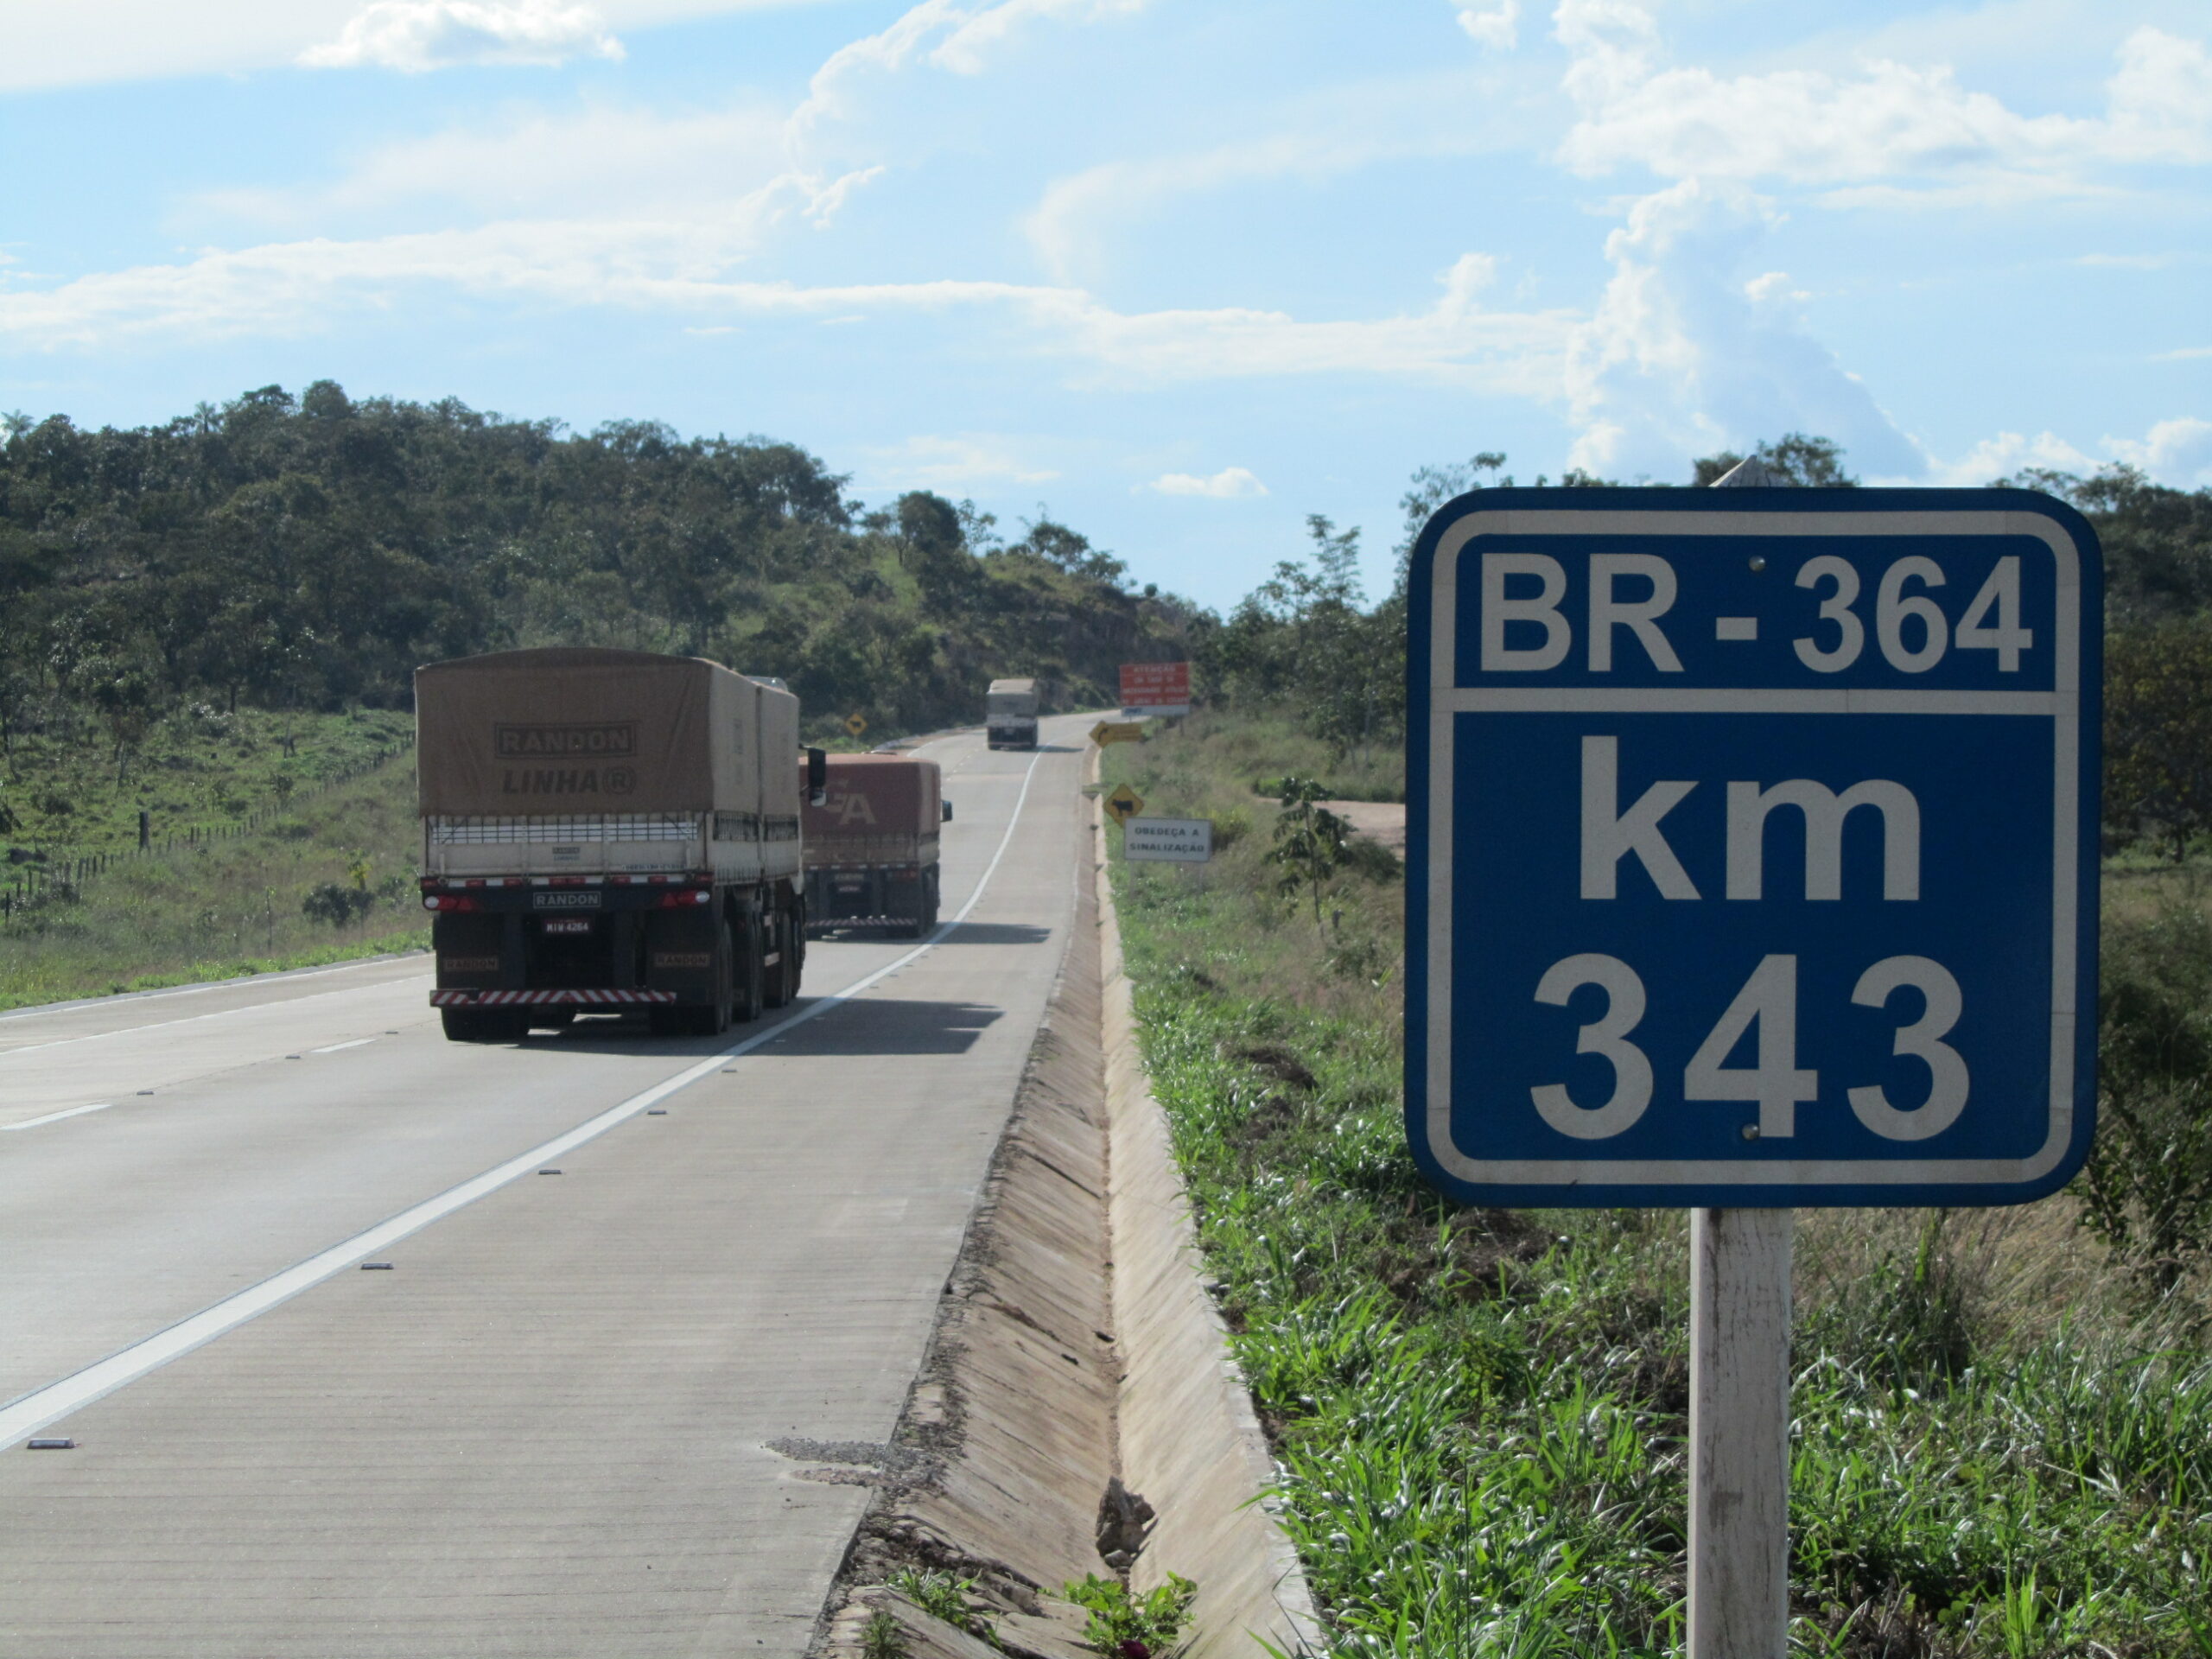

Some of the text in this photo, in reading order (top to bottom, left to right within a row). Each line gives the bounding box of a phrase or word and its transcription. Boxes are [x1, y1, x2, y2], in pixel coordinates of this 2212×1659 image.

[1480, 553, 1684, 671] BR
[1792, 556, 2033, 672] 364
[502, 728, 629, 754] RANDON
[1580, 735, 1920, 900] km
[1135, 826, 1185, 838] OBEDEÇA
[1129, 842, 1204, 853] SINALIZAÇÃO
[536, 893, 599, 906] RANDON
[447, 958, 496, 969] RANDON
[1530, 952, 1970, 1141] 343
